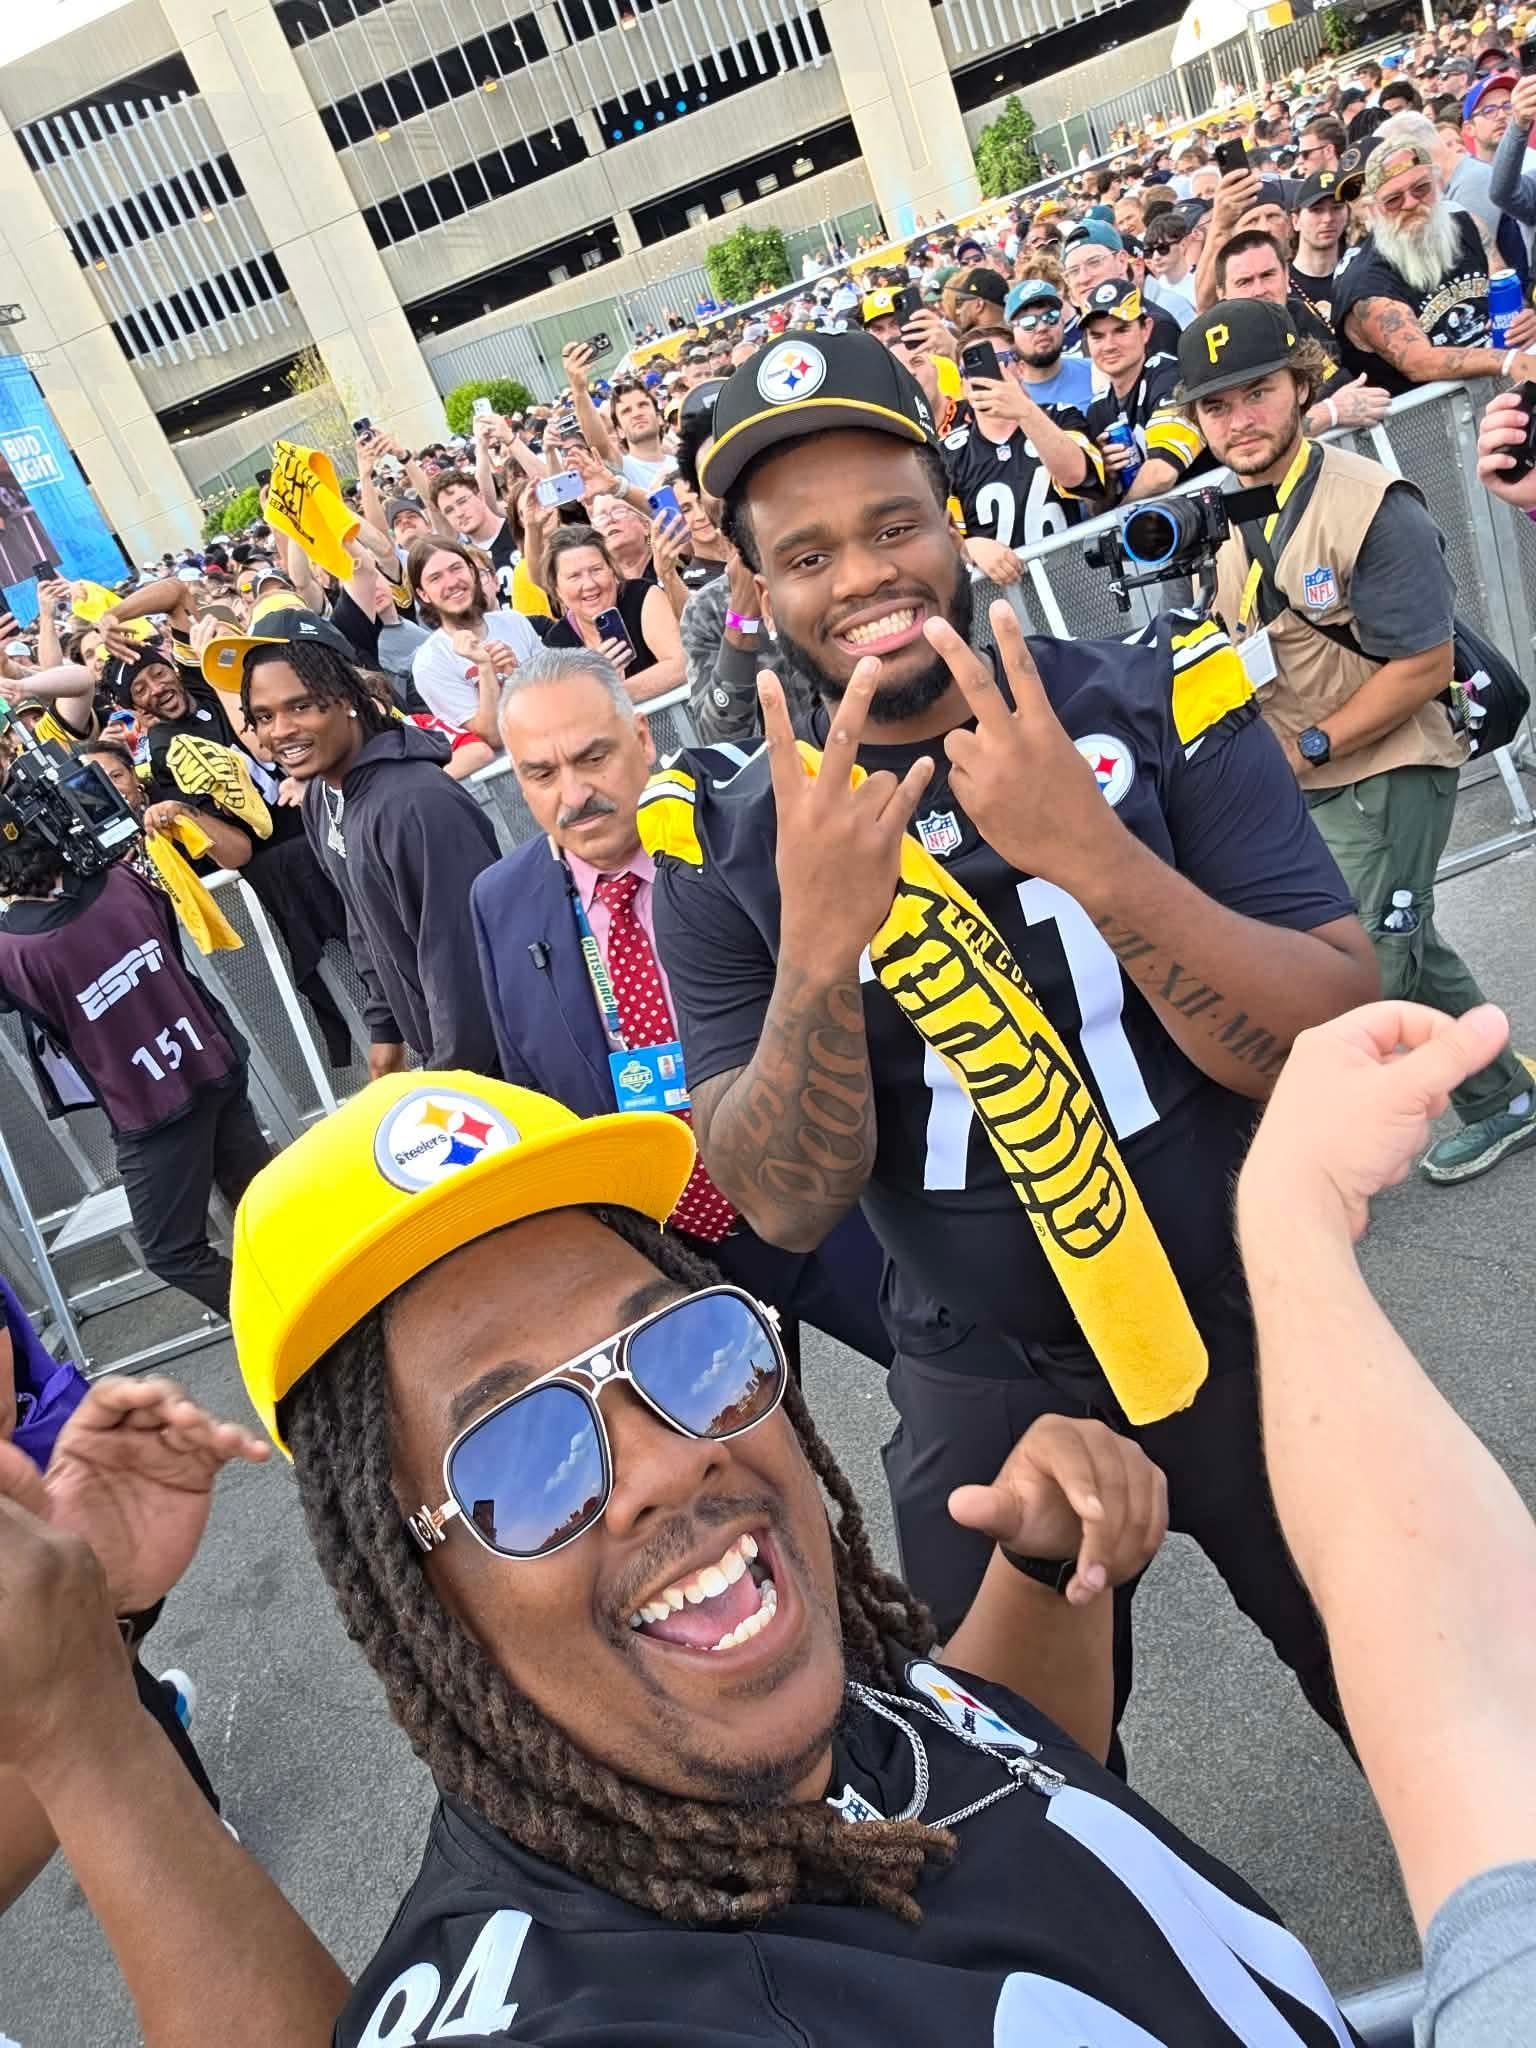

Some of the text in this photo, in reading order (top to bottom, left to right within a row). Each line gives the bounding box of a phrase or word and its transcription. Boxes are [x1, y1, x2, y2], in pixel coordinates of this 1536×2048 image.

[1205, 323, 1230, 364] P
[2, 434, 41, 462] BUD
[976, 465, 1068, 546] 26
[1308, 581, 1335, 603] NFL
[927, 828, 956, 849] NFL
[76, 938, 164, 1022] ESPN
[583, 939, 618, 1013] PITTSBURGH
[131, 1016, 204, 1081] 151
[394, 1133, 448, 1166] Steelers
